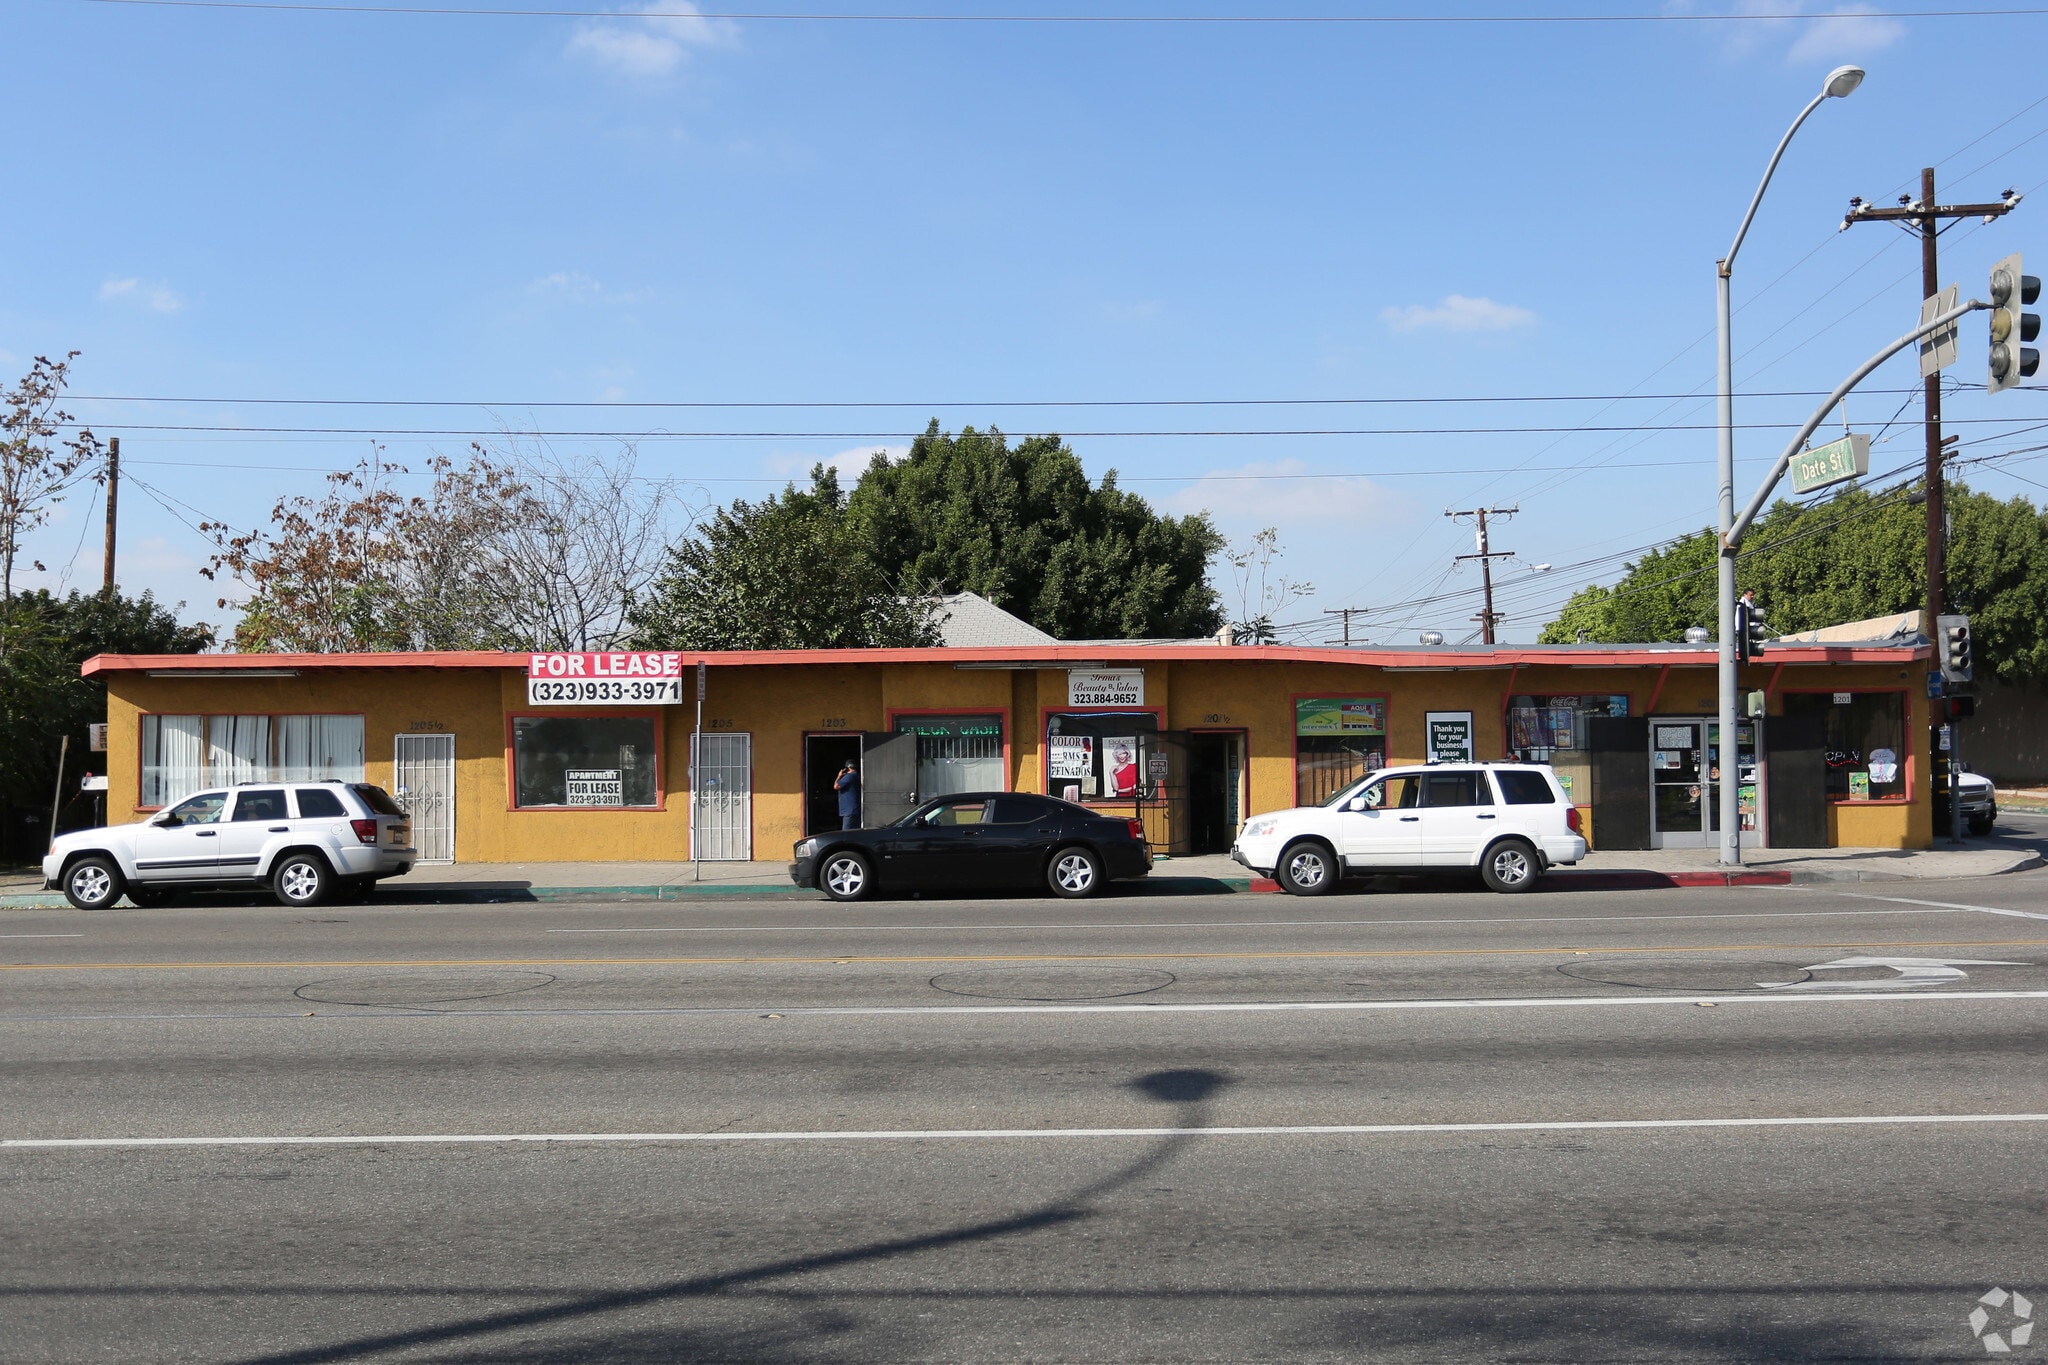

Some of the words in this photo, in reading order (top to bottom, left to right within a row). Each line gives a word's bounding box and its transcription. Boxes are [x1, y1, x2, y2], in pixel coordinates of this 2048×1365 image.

[1802, 460, 1826, 480] Date
[1829, 452, 1843, 471] St
[532, 654, 586, 676] FOR
[594, 653, 679, 675] LEASE
[532, 681, 679, 701] (323)933-3971
[1073, 682, 1107, 692] Beauty
[1113, 682, 1138, 692] Salon
[1074, 693, 1137, 704] 323.884-9652
[707, 719, 733, 728] 1205
[821, 719, 846, 727] 1203
[1453, 726, 1465, 734] you
[1051, 736, 1081, 747] COLOR
[1448, 734, 1463, 742] your
[1440, 750, 1460, 759] please
[1656, 752, 1664, 761] A
[569, 771, 618, 780] APARTMENT
[1051, 766, 1091, 776] PEINADOS
[569, 783, 588, 794] FOR
[590, 783, 620, 794] LEASE
[570, 795, 620, 804] 323-933-3971
